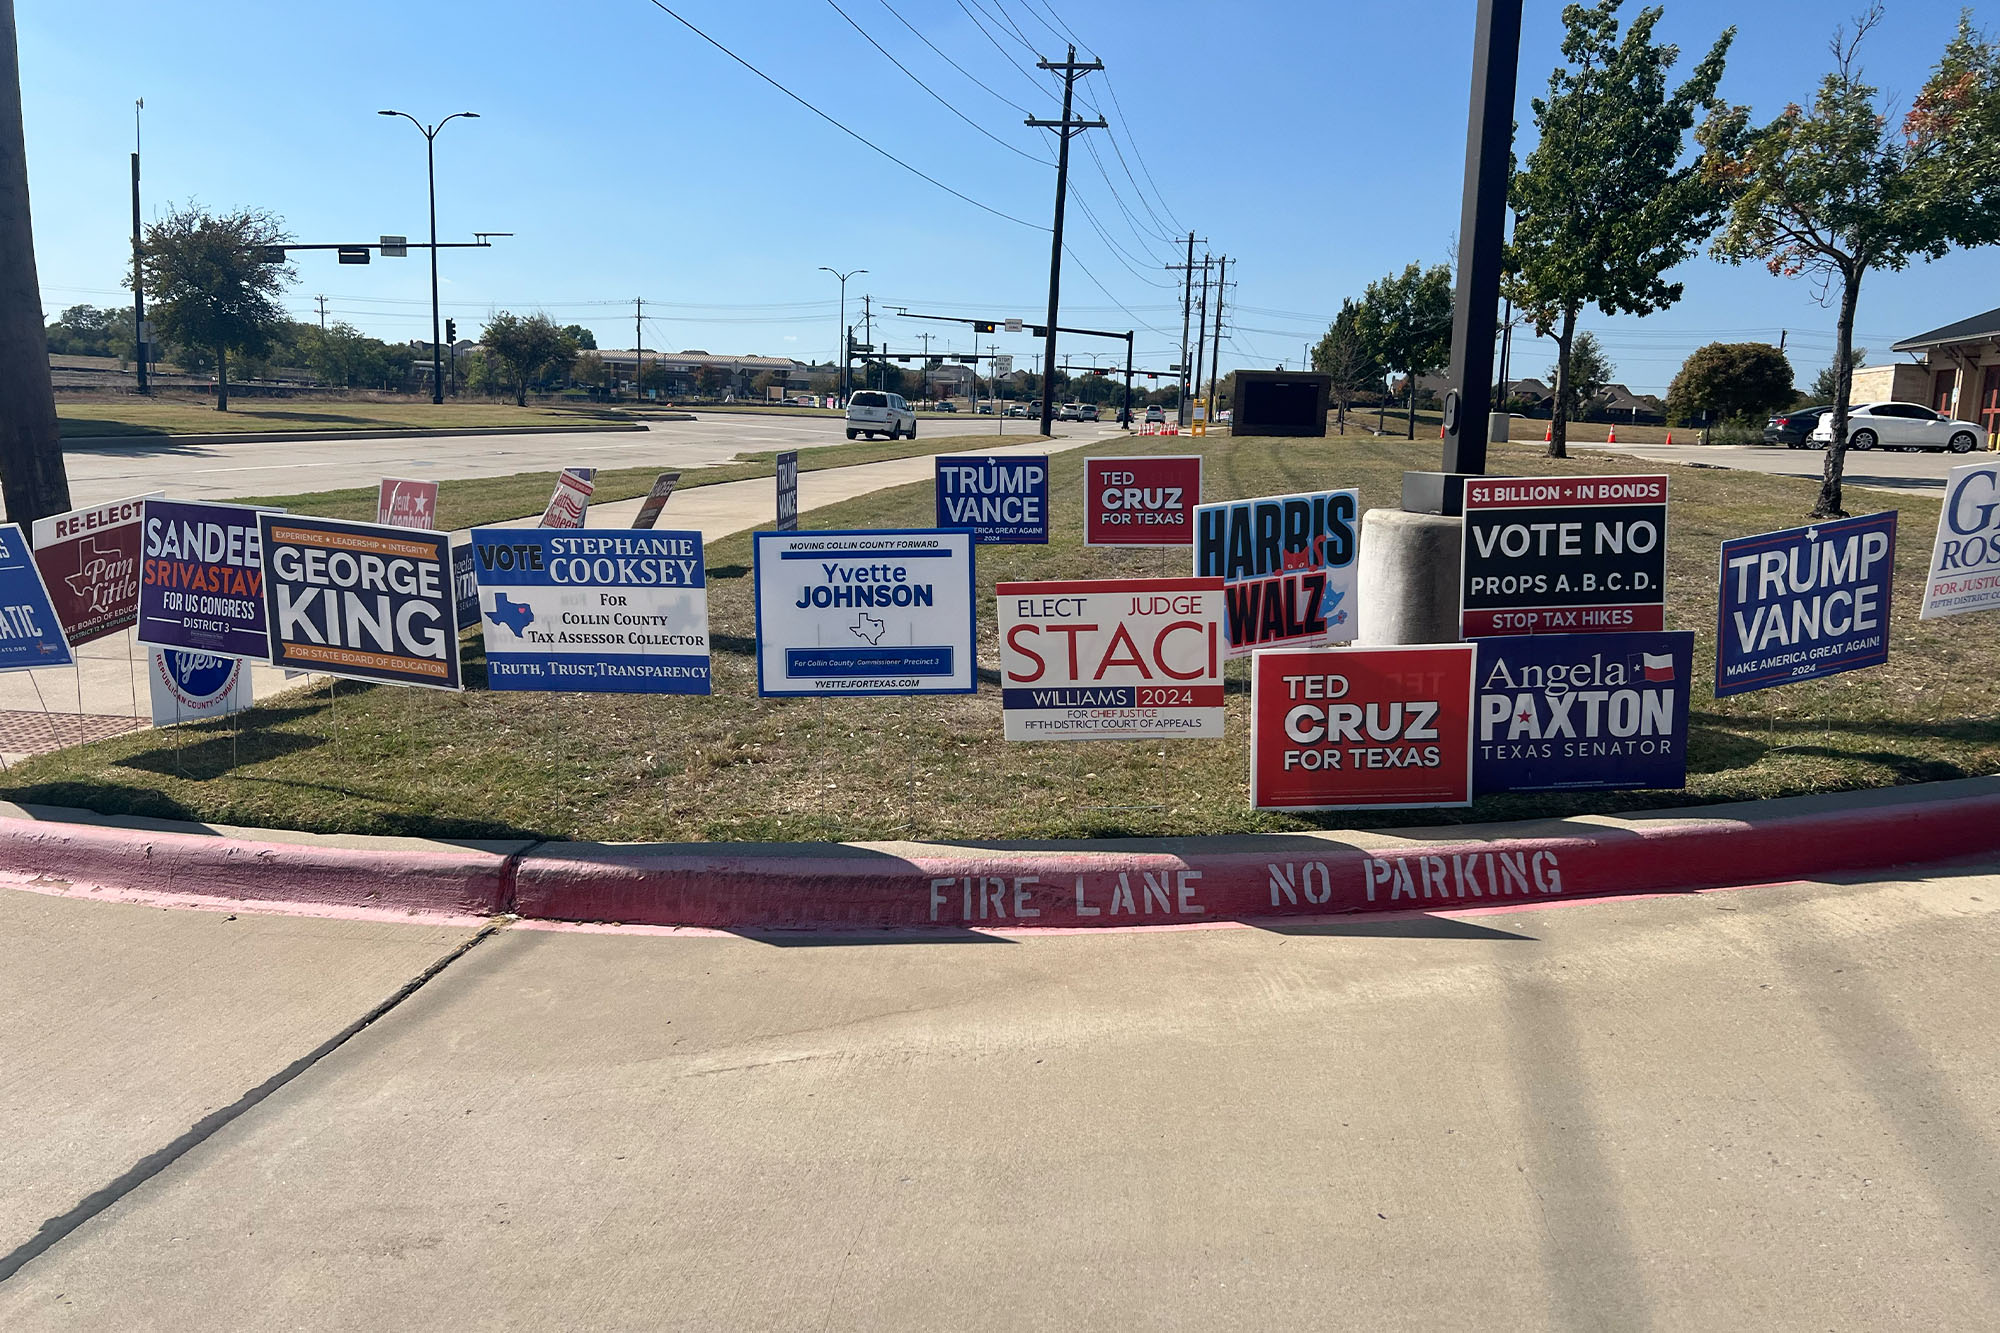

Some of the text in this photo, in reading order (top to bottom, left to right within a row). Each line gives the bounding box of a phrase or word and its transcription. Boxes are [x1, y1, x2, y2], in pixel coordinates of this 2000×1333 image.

[778, 461, 797, 491] TRUMP
[940, 466, 1044, 494] TRUMP
[1100, 471, 1135, 485] TED
[1101, 487, 1183, 510] CRUZ
[1472, 488, 1490, 503] $1
[1494, 485, 1560, 502] BILLION
[1577, 485, 1594, 499] IN
[1598, 483, 1660, 499] BONDS
[1948, 470, 2000, 535] G
[56, 501, 143, 538] RE-ELECT
[945, 496, 1040, 523] VANCE
[1101, 513, 1184, 524] FOR TEXAS
[147, 517, 260, 568] SANDEE
[275, 530, 428, 555] EXPERIENCE LEADERSHIP INTEGRITY
[551, 537, 694, 557] STEPHANIE
[789, 540, 939, 550] MOVING COLLIN COUNTY FORWARD
[1198, 492, 1355, 581] HARRIS
[1472, 520, 1657, 558] VOTE NO
[85, 557, 133, 584] Pam
[477, 544, 545, 571] VOTE
[549, 557, 698, 585] COOKSEY
[1728, 531, 1889, 605] TRUMP
[144, 559, 264, 598] SRIVASTAV
[273, 546, 443, 599] GEORGE
[822, 563, 907, 583] Yvette
[1471, 574, 1547, 595] PROPS
[89, 575, 137, 613] Little
[795, 584, 933, 608] JOHNSON
[1930, 598, 1953, 609] FIFTH
[1953, 592, 1990, 605] DISTRICT
[1932, 582, 1958, 597] FOR
[77, 616, 102, 630] BOARD
[104, 612, 113, 621] OF
[114, 604, 138, 617] EDUCA
[163, 591, 255, 620] FOR US CONGRESS
[1017, 596, 1202, 618] ELECT JUDGE
[1224, 572, 1327, 648] WALZ
[1733, 584, 1879, 654] VANCE
[0, 605, 43, 639] ATIC
[183, 617, 230, 633] DISTRICT 3
[276, 583, 447, 660] KING
[1492, 610, 1633, 629] STOP TAX HIKES
[69, 628, 93, 641] DISTRICT
[290, 647, 445, 674] FOR STATE BOARD OF EDUCATION
[794, 659, 806, 667] For
[807, 658, 828, 667] Collin
[829, 658, 855, 667] County
[1006, 621, 1217, 683] STACI
[1726, 661, 1758, 676] MAKE
[1760, 652, 1808, 670] AMERICA
[1809, 644, 1843, 659] GREAT
[1845, 636, 1880, 653] AGAIN!
[156, 654, 243, 710] REPUBLICAN COUNTY COMMISSION
[1481, 653, 1628, 697] Angela
[1791, 664, 1817, 676] 2024
[815, 679, 920, 689] YVETTEJFORTEXAS.COM
[1032, 688, 1193, 706] WILLIAMS 2024
[1282, 674, 1349, 699] TED
[1025, 718, 1202, 729] FIFTH DISTRICT COURT OF APPEALS
[1067, 709, 1157, 718] FOR CHIEF JUSTICE
[1284, 701, 1440, 744] CRUZ
[1480, 688, 1675, 741] PAXTON
[1284, 746, 1440, 770] FOR TEXAS
[1480, 740, 1671, 760] TEXAS SENATOR
[929, 850, 1562, 921] FIRE LANE NO PARKING
